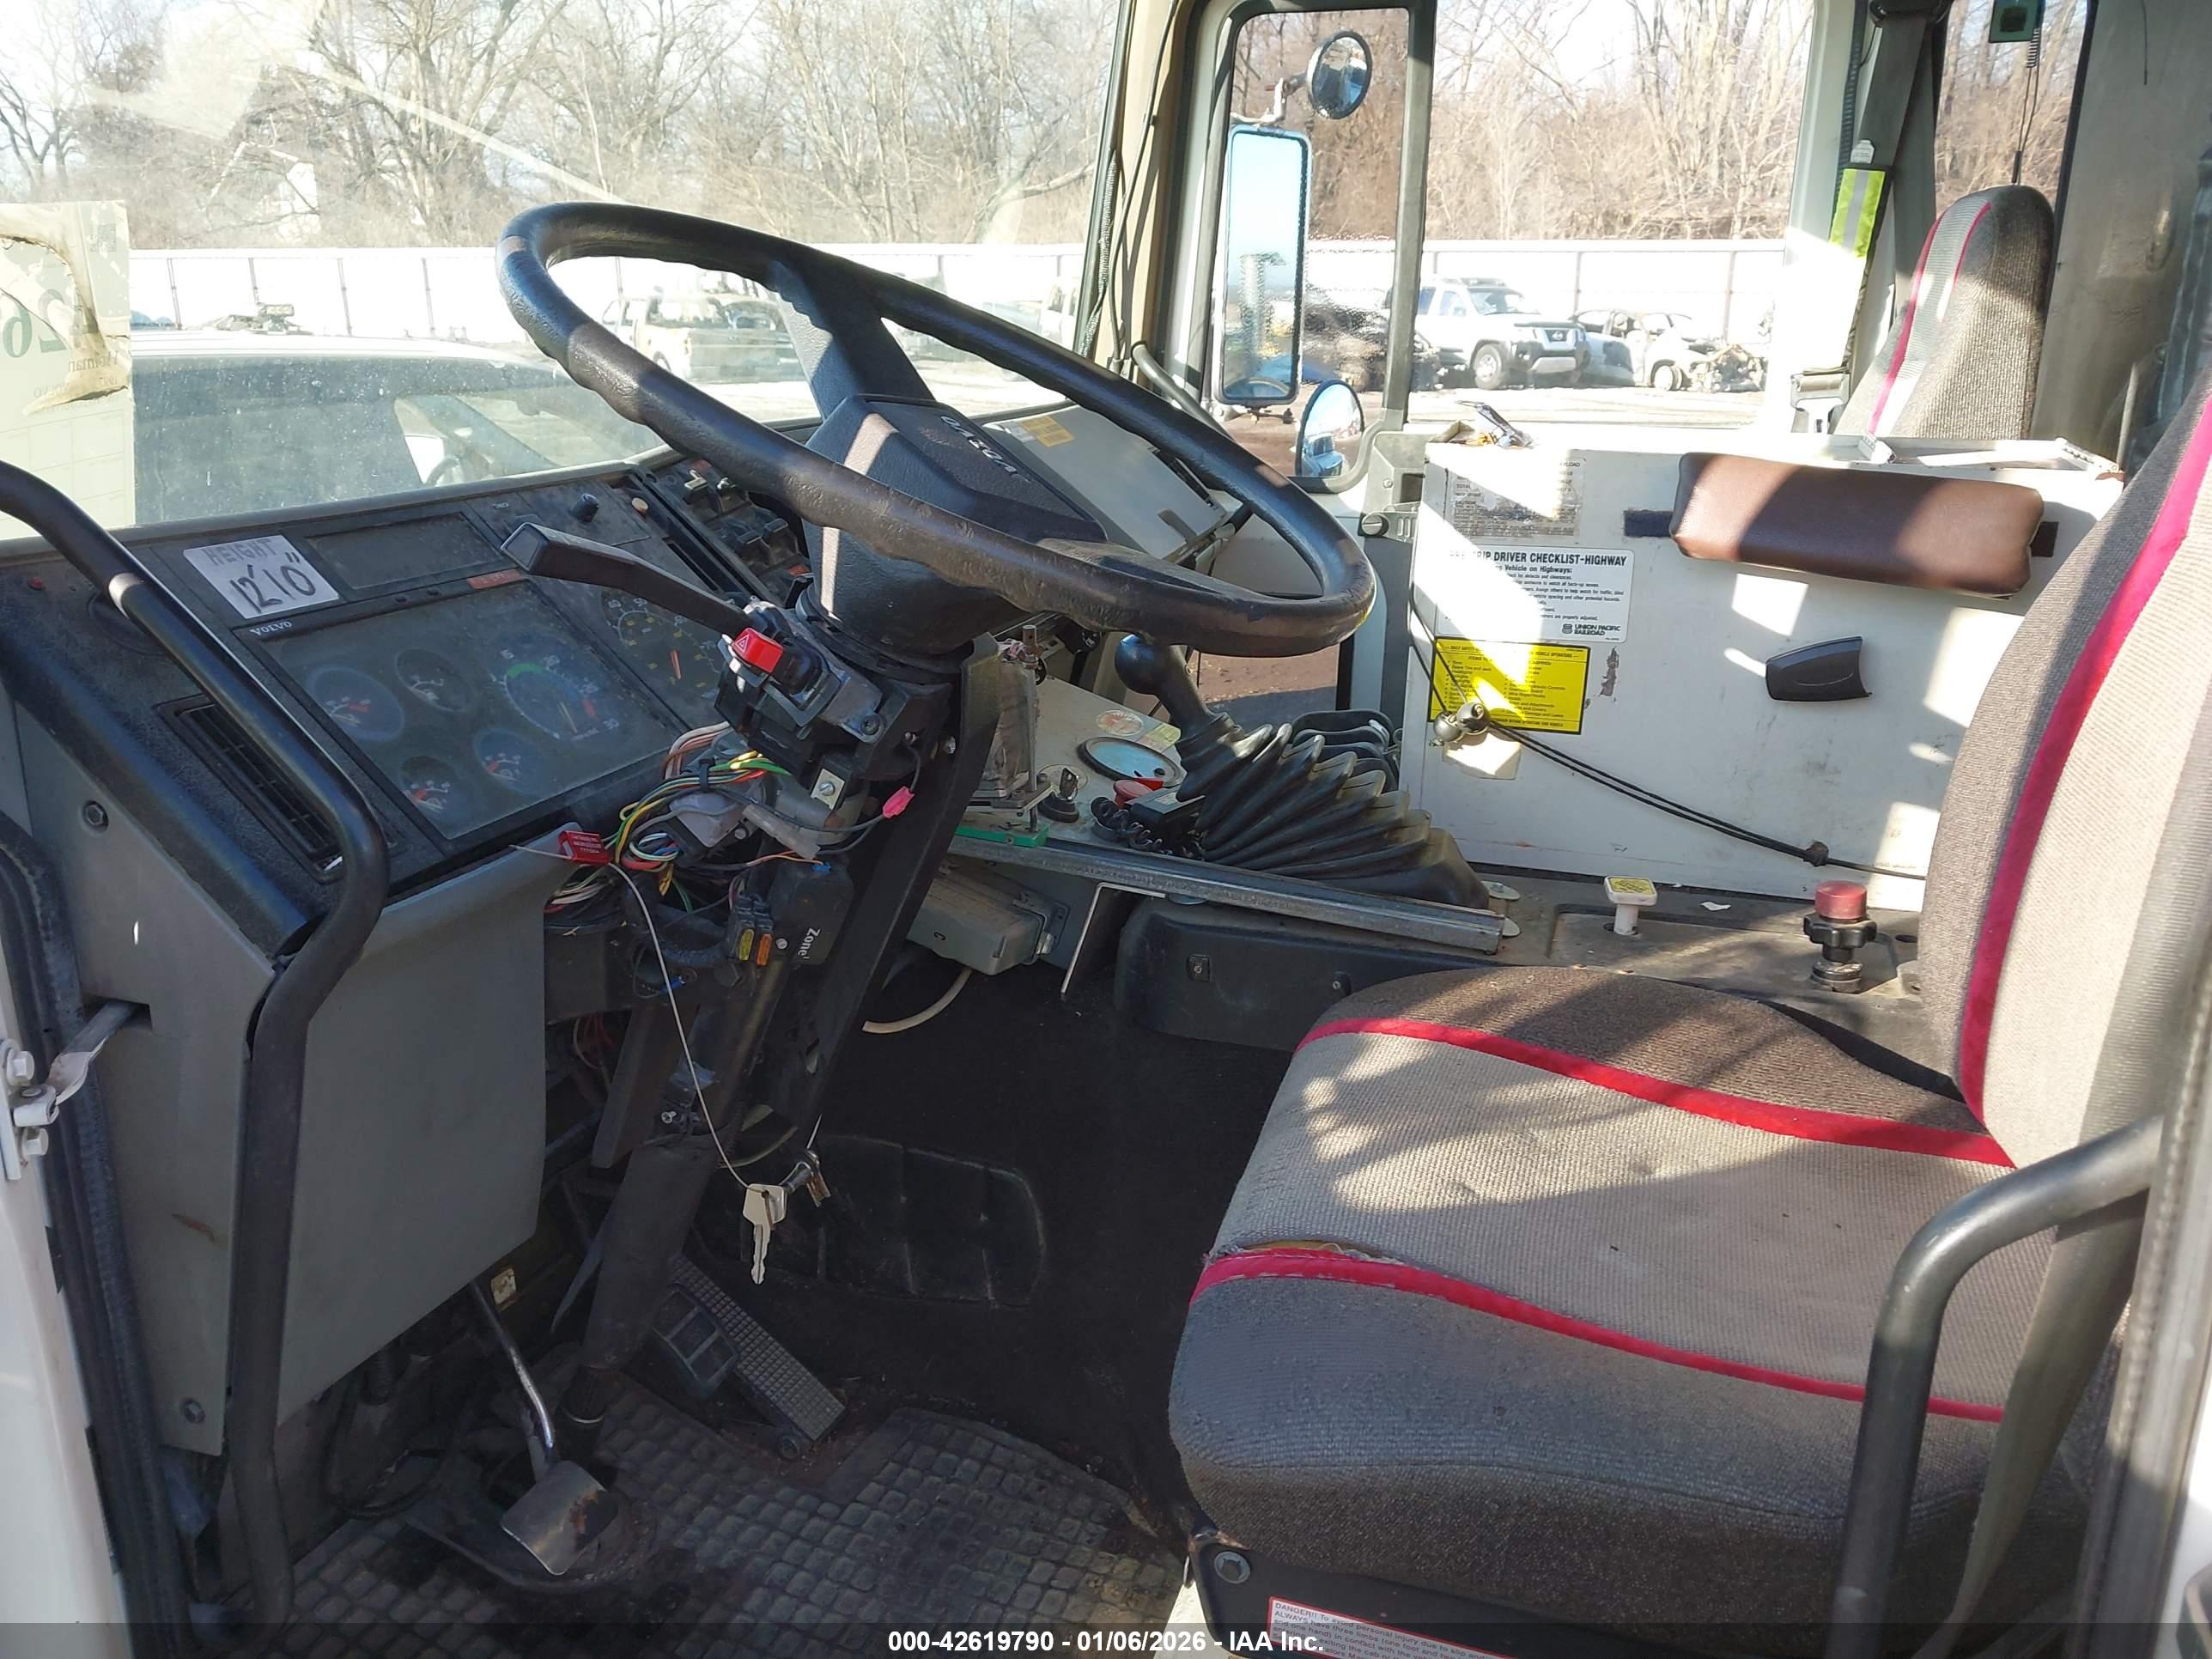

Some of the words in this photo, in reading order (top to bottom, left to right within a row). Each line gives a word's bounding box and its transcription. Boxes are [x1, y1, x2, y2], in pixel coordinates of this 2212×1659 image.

[202, 538, 277, 567] HEIGHT
[1493, 551, 1527, 563] DRIVER
[1529, 553, 1627, 567] CHECKLIST-HIGHWAY
[1540, 565, 1573, 574] Highways:
[248, 620, 294, 637] VOLVO
[1274, 1611, 1308, 1625] ALWAYS
[1310, 1620, 1330, 1631] have
[1333, 1625, 1354, 1637] three
[1357, 1632, 1379, 1643] limbs
[1381, 1638, 1401, 1648] (one
[1402, 1643, 1419, 1652] foot
[1422, 1648, 1438, 1657] and
[1291, 1623, 1306, 1632] one
[1309, 1626, 1332, 1639] hand)
[1345, 1636, 1375, 1650] contact
[1377, 1644, 1395, 1655] with
[1397, 1649, 1411, 1658] the
[1320, 1613, 1329, 1622] To
[1332, 1617, 1354, 1628] avoid
[1357, 1624, 1393, 1638] personal
[1395, 1632, 1419, 1646] injury
[1421, 1639, 1437, 1650] due
[1450, 1648, 1467, 1657] slip
[1319, 1638, 1346, 1650] exiting
[1364, 1650, 1380, 1658] cab
